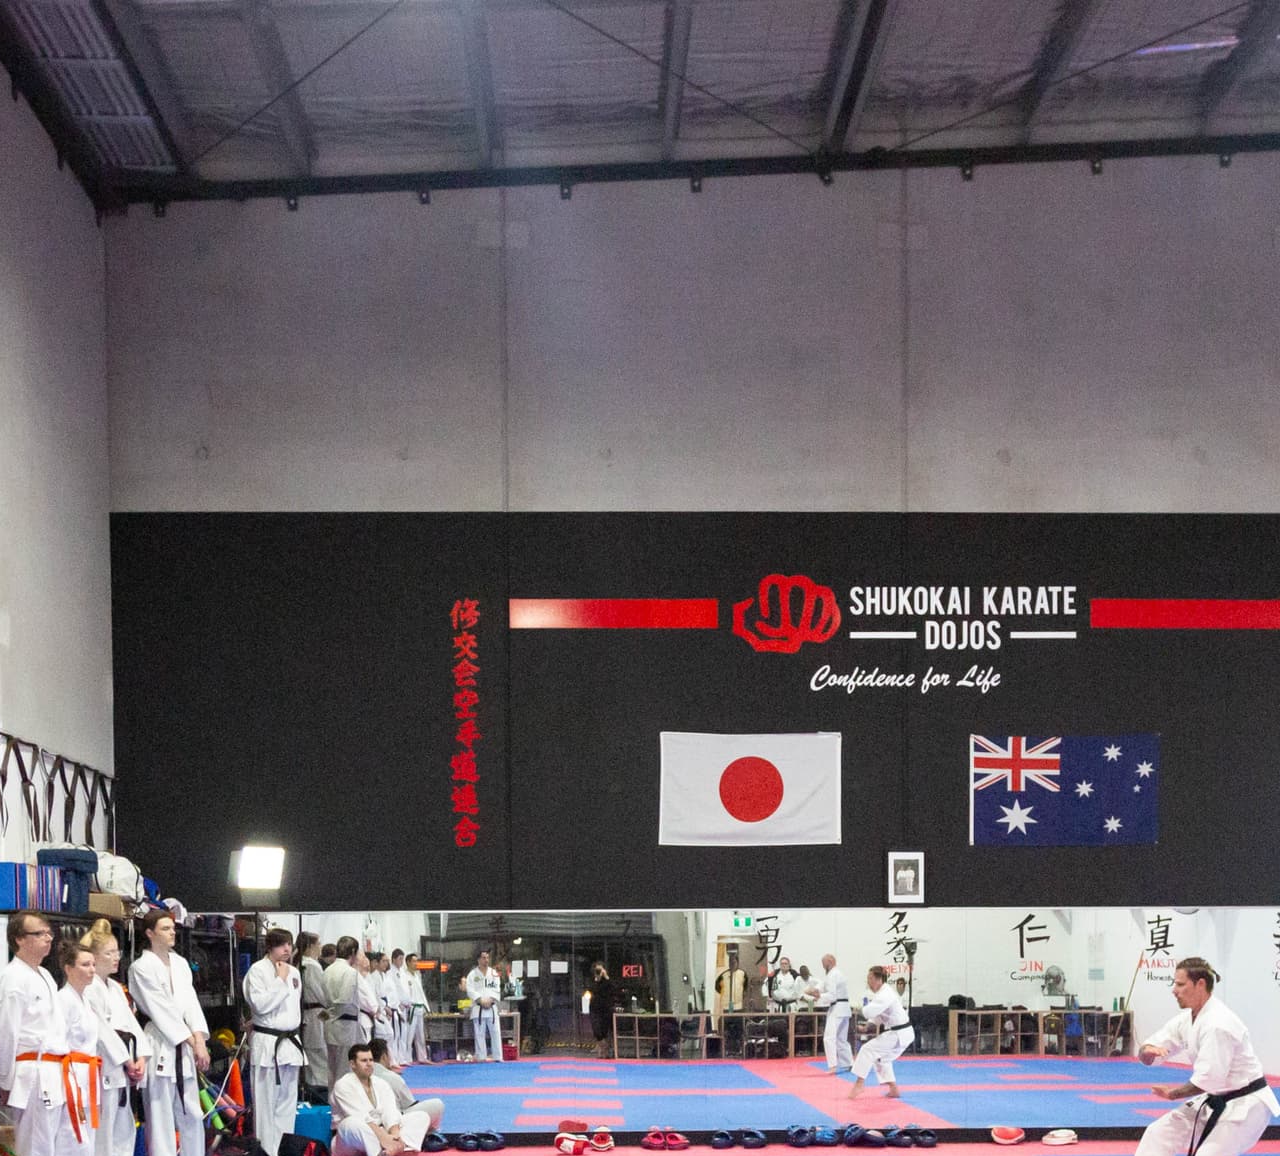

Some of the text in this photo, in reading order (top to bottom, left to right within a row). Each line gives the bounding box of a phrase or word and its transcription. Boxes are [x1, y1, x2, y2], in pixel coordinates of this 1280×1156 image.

[849, 586, 1078, 616] SHUKOKAI KARATE
[924, 620, 1002, 650] DOJOS
[809, 664, 1002, 694] Confidence for Life
[1010, 913, 1051, 959] 仁
[1145, 914, 1175, 957] 真
[1019, 960, 1044, 972] JIN
